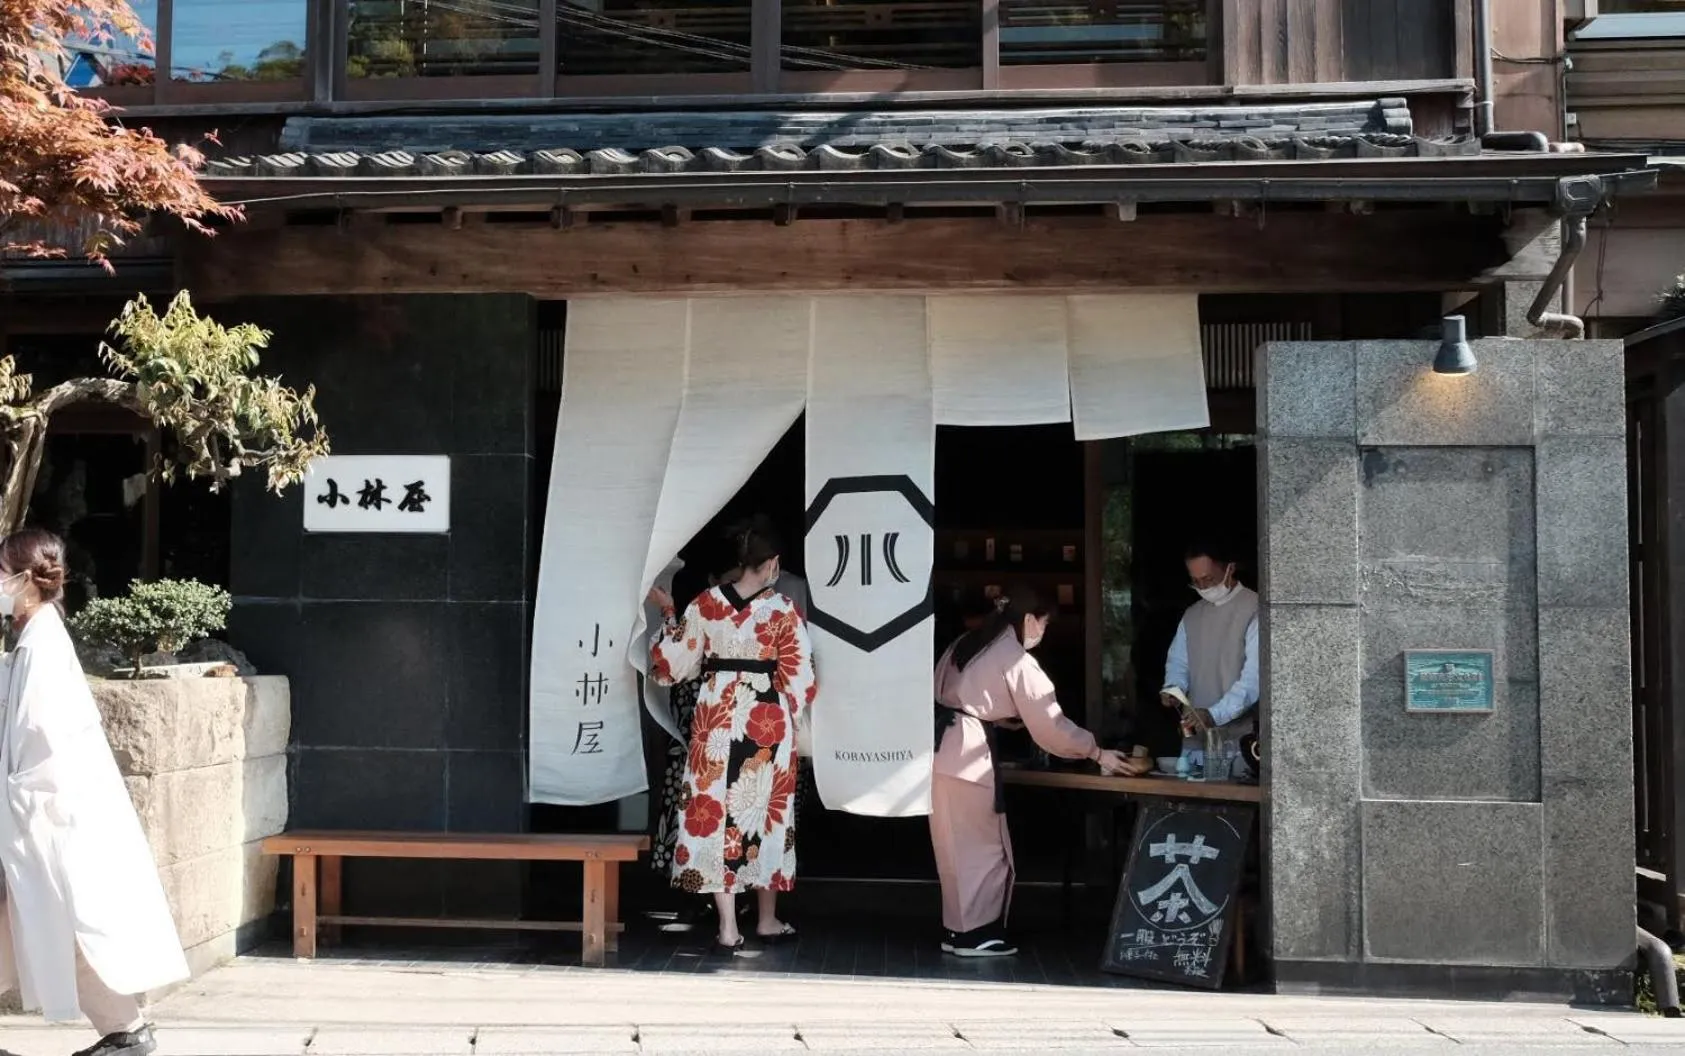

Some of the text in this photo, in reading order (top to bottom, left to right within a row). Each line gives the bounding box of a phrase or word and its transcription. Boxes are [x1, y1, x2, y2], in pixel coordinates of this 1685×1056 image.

[317, 478, 431, 512] 小林屋
[571, 623, 613, 755] 小林屋
[1137, 833, 1220, 923] 茶
